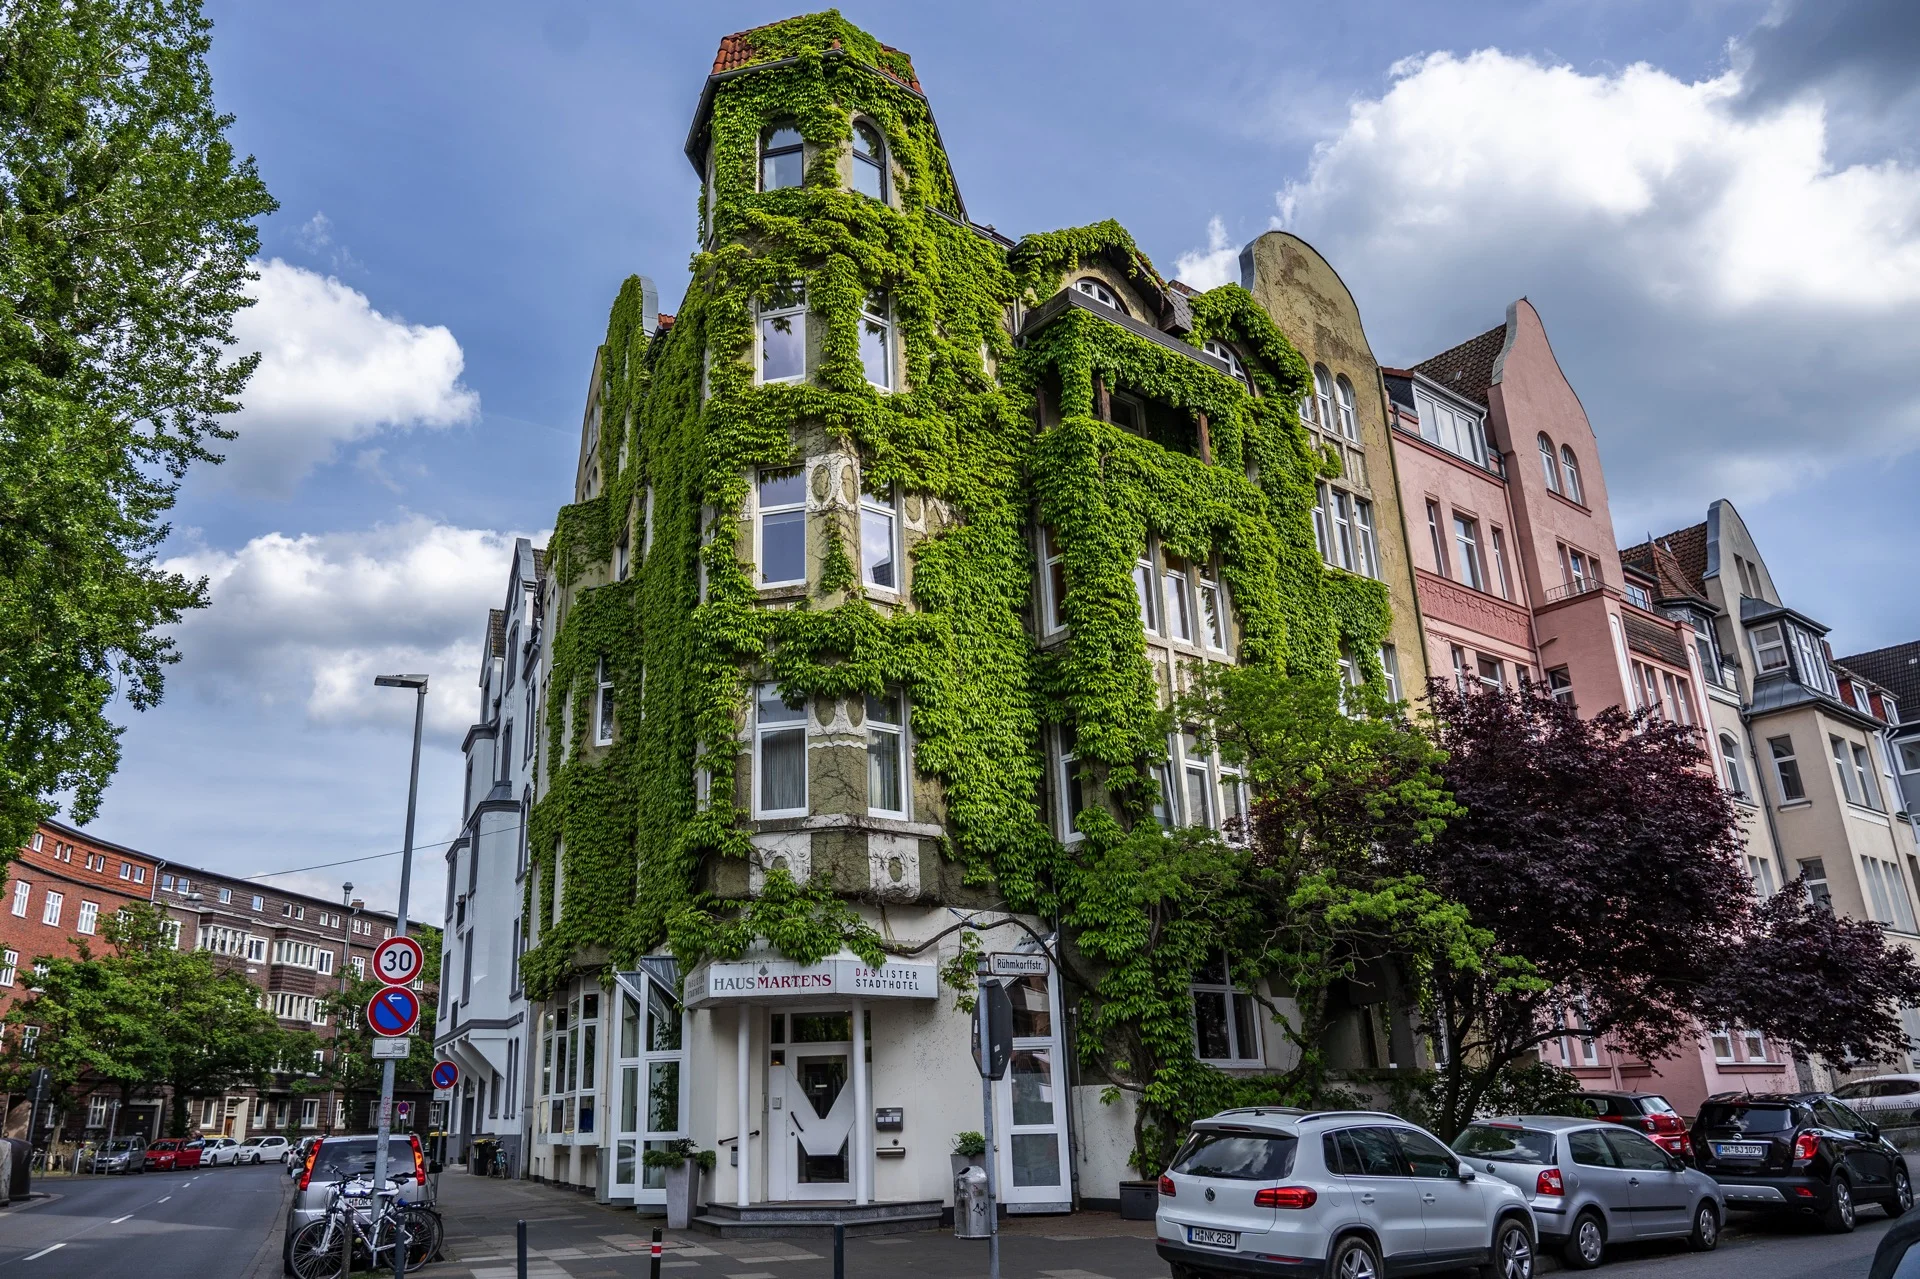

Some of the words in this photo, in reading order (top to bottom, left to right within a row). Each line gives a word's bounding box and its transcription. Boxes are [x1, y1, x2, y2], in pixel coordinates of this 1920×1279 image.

[383, 950, 412, 971] 30
[997, 959, 1043, 970] Rühmkorffstr.
[714, 977, 755, 990] HAUS
[757, 974, 832, 989] MARTENS
[855, 979, 919, 990] STADTHOTEL
[1216, 1232, 1232, 1245] 258
